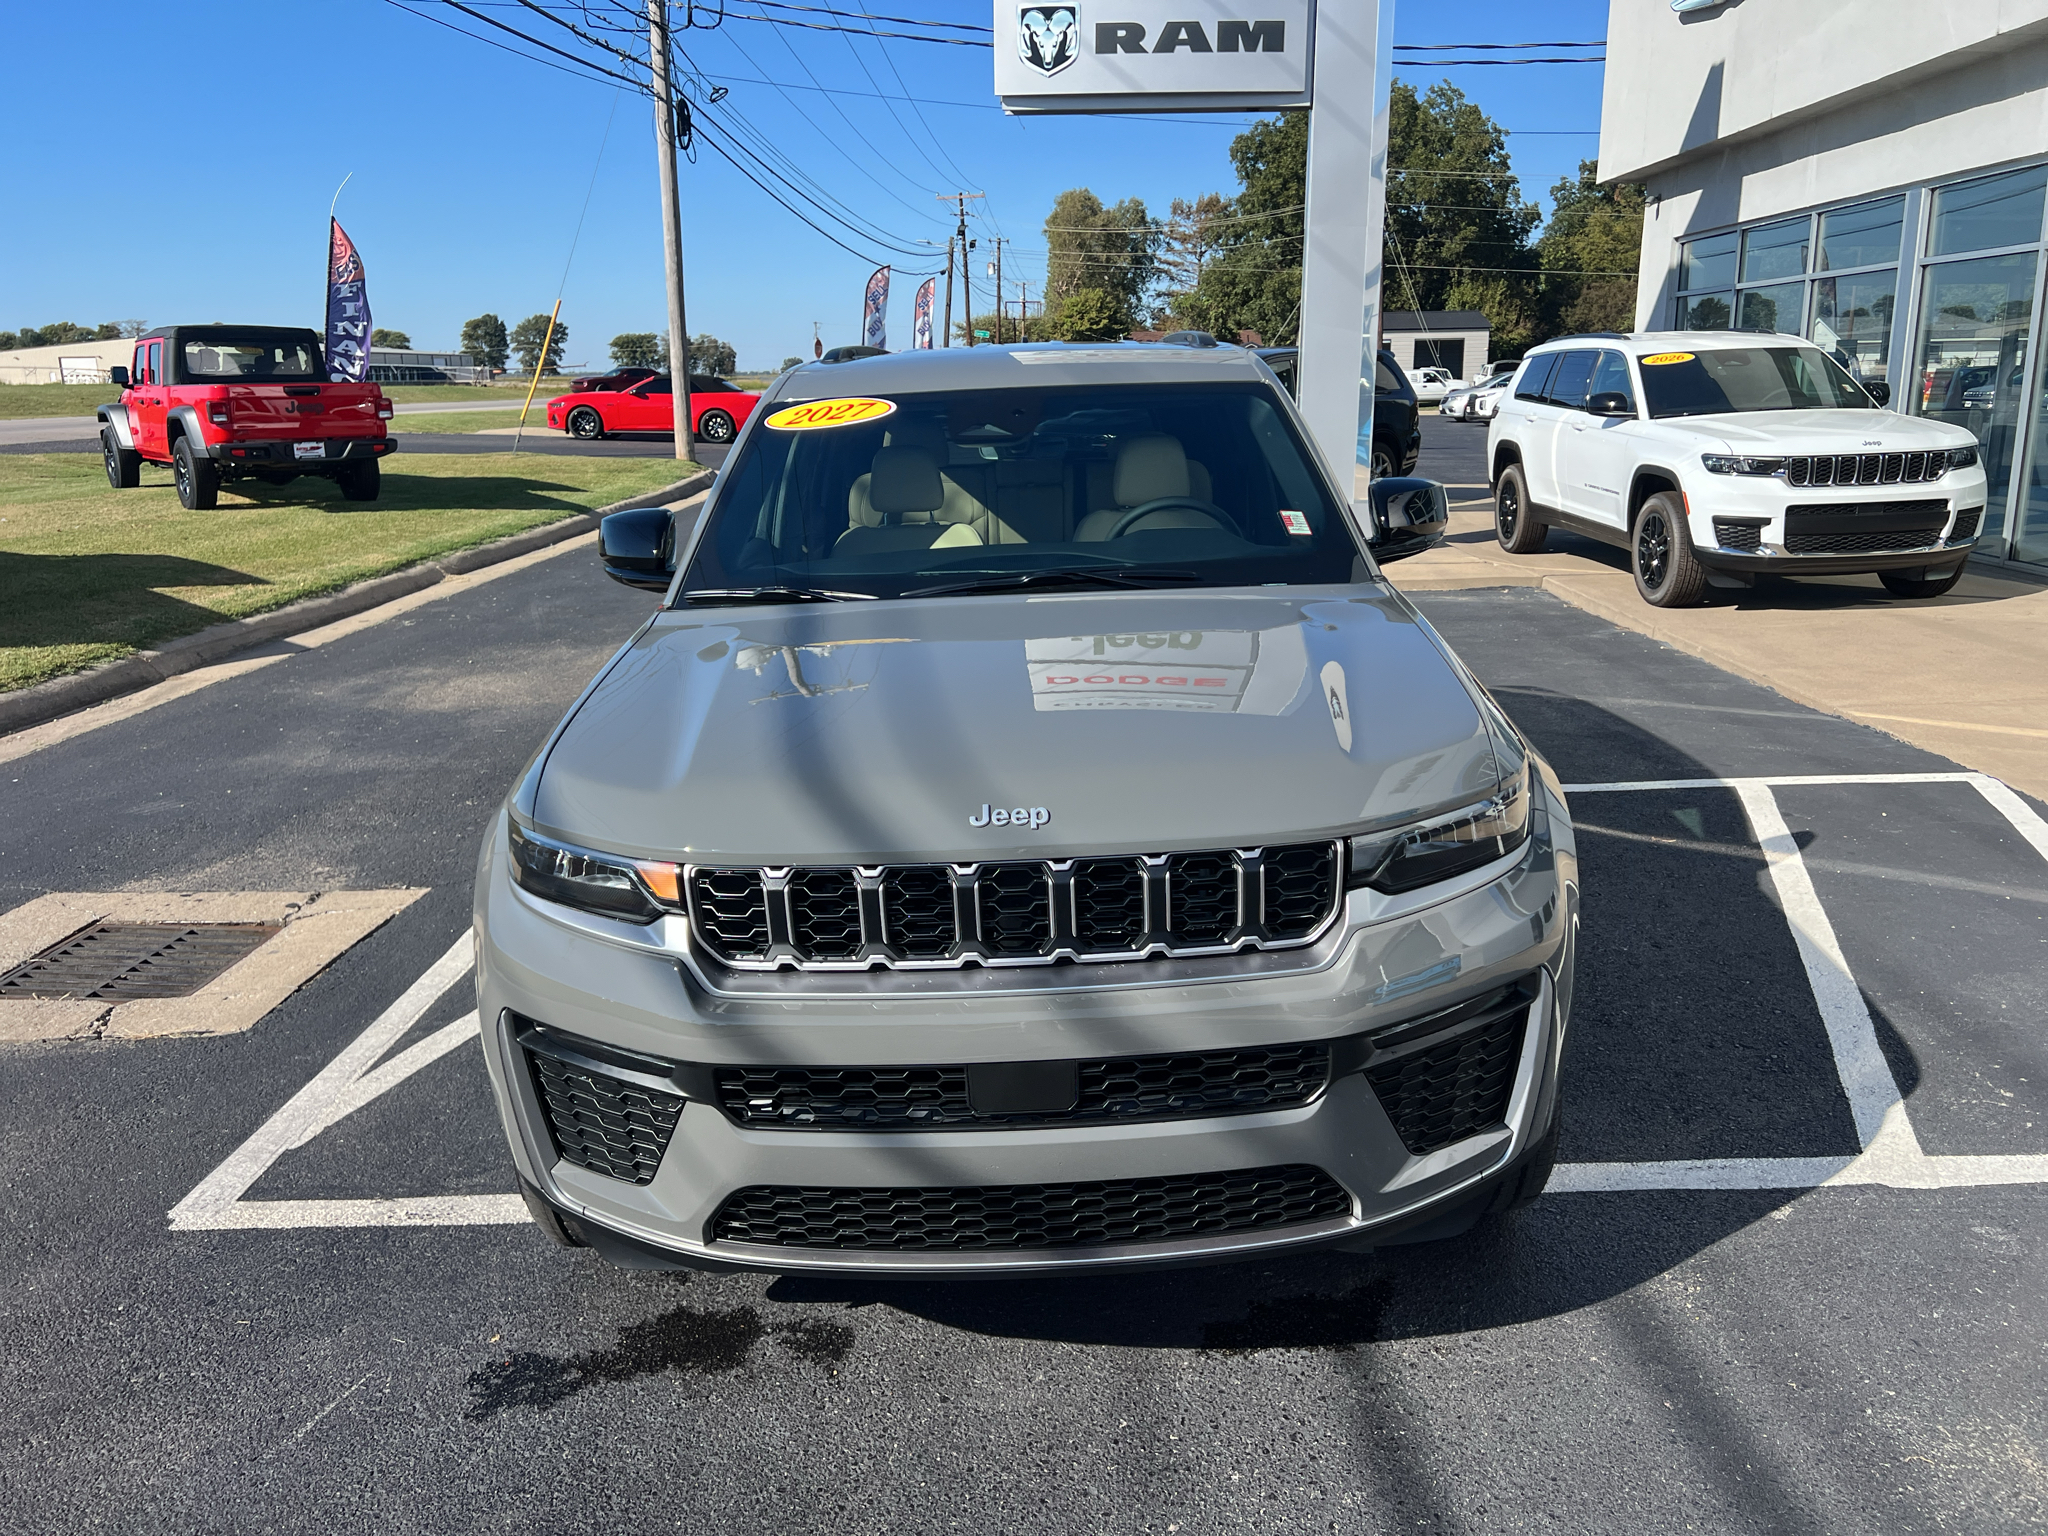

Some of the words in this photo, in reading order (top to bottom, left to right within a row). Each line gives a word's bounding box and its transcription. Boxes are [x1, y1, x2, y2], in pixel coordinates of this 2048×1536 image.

[1095, 20, 1285, 54] RAM
[867, 285, 888, 305] SELL
[917, 293, 935, 311] SELL
[867, 316, 884, 337] BUY
[917, 319, 931, 336] BUY
[1651, 355, 1684, 364] 2026
[285, 401, 325, 415] Jeep
[784, 403, 877, 426] 2027
[969, 804, 1051, 830] Jeep
